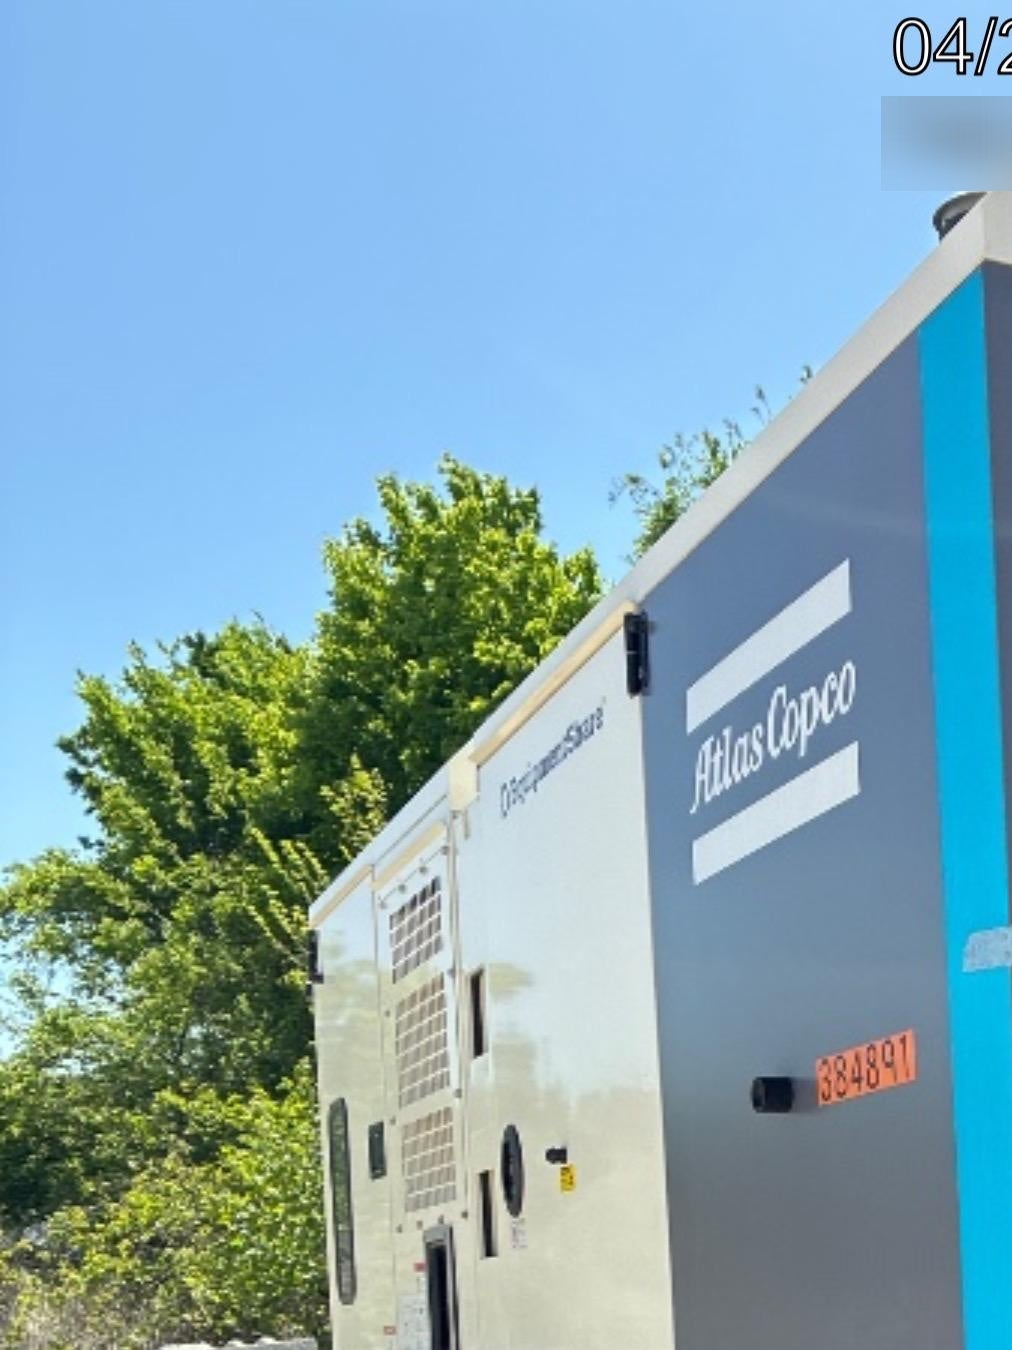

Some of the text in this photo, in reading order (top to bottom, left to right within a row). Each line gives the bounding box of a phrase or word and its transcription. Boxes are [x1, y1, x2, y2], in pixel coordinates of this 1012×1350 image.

[689, 660, 857, 815] Atlas Copco
[819, 1034, 911, 1102] 384891
